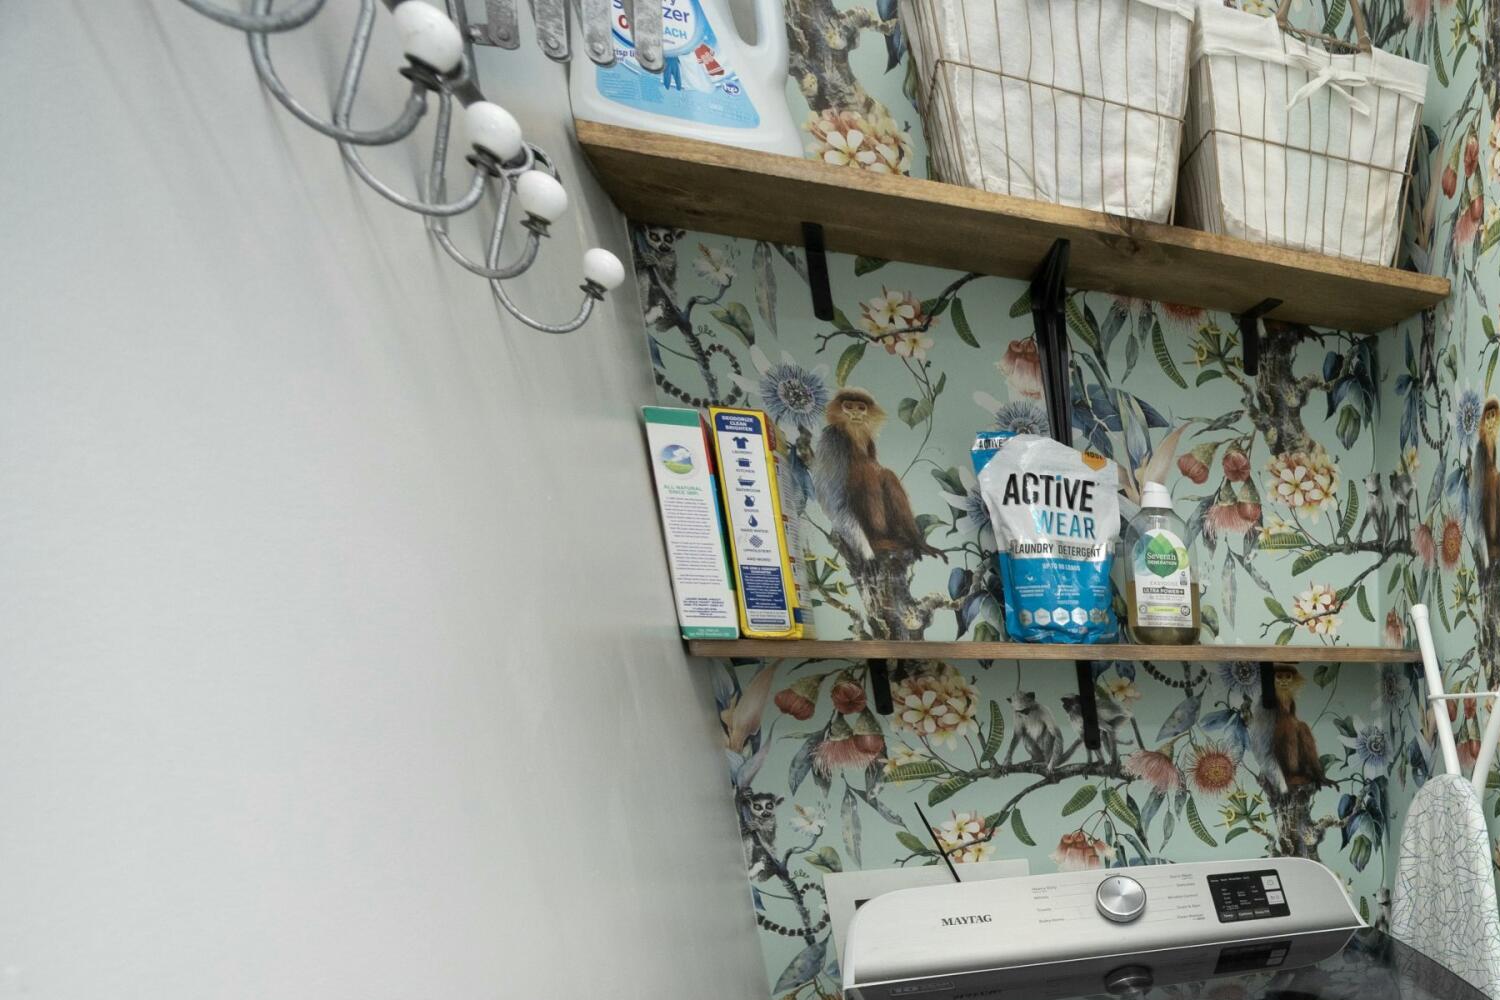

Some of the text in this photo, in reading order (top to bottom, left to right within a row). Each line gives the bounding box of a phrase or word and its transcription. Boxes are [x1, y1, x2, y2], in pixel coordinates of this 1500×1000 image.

[1036, 510, 1096, 540] WEAR
[1015, 543, 1054, 555] LAUNDRY
[1058, 543, 1101, 558] DETERGENT
[1146, 552, 1177, 560] Seventh
[941, 914, 992, 927] MAYTAG
